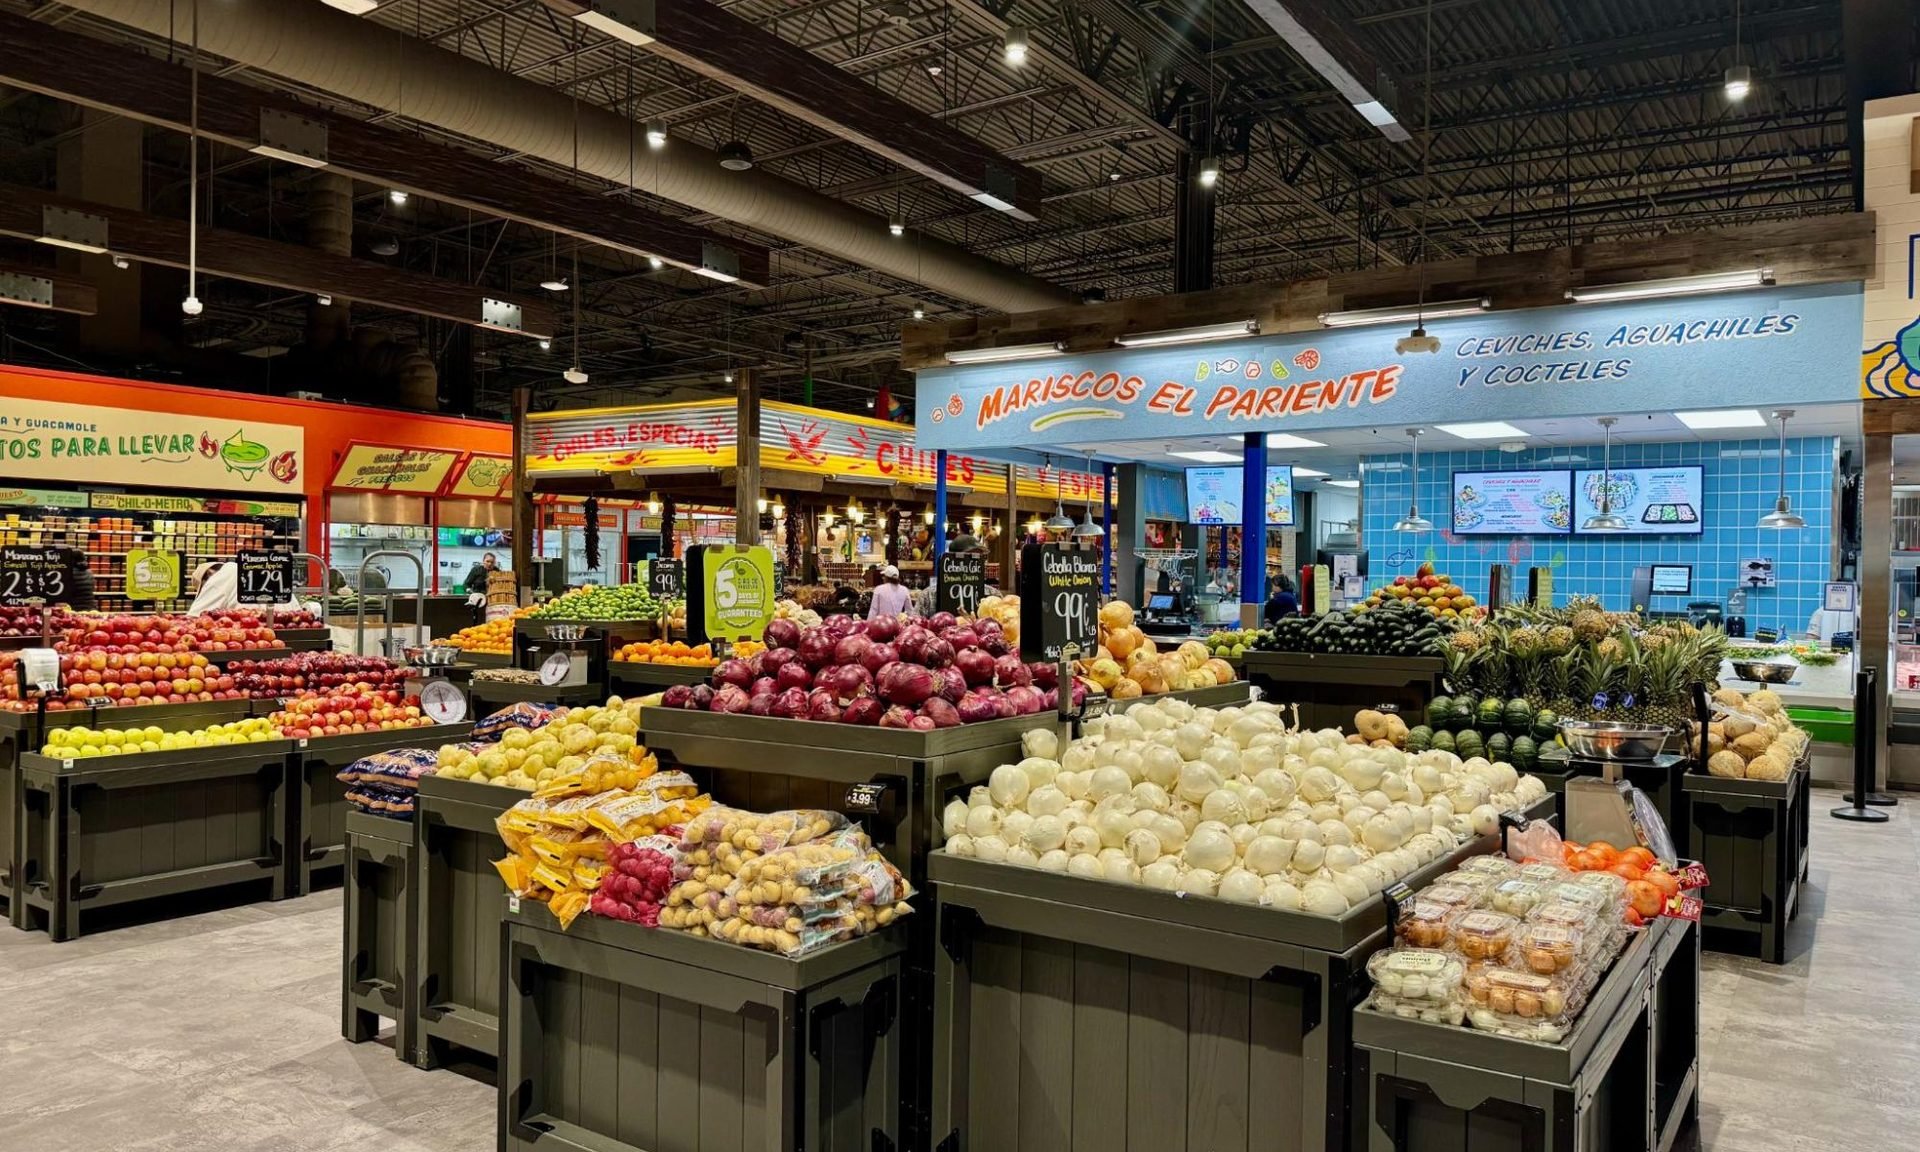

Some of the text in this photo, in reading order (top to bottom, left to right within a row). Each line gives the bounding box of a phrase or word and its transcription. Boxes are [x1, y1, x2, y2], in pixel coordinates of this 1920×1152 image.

[1456, 314, 1800, 358] CEVICHES, AGUACHILES
[1458, 359, 1632, 388] Y COCTELES
[977, 364, 1404, 430] MARISCOS EL PARIENTE
[14, 418, 21, 427] Y
[26, 418, 97, 432] GUACAMOLE
[52, 437, 111, 458] PARA
[118, 433, 195, 456] LLEVAR
[553, 427, 616, 461] CHILES
[628, 423, 719, 454] ESPECIAS
[373, 452, 426, 463] SALSAS Y
[5, 550, 43, 560] Manzana
[1043, 552, 1097, 574] Cebolla Blanca
[134, 561, 151, 582] 5
[1049, 574, 1091, 587] White Onion
[2, 571, 21, 597] 2
[716, 569, 738, 608] 5
[718, 608, 763, 618] GUARANTEED
